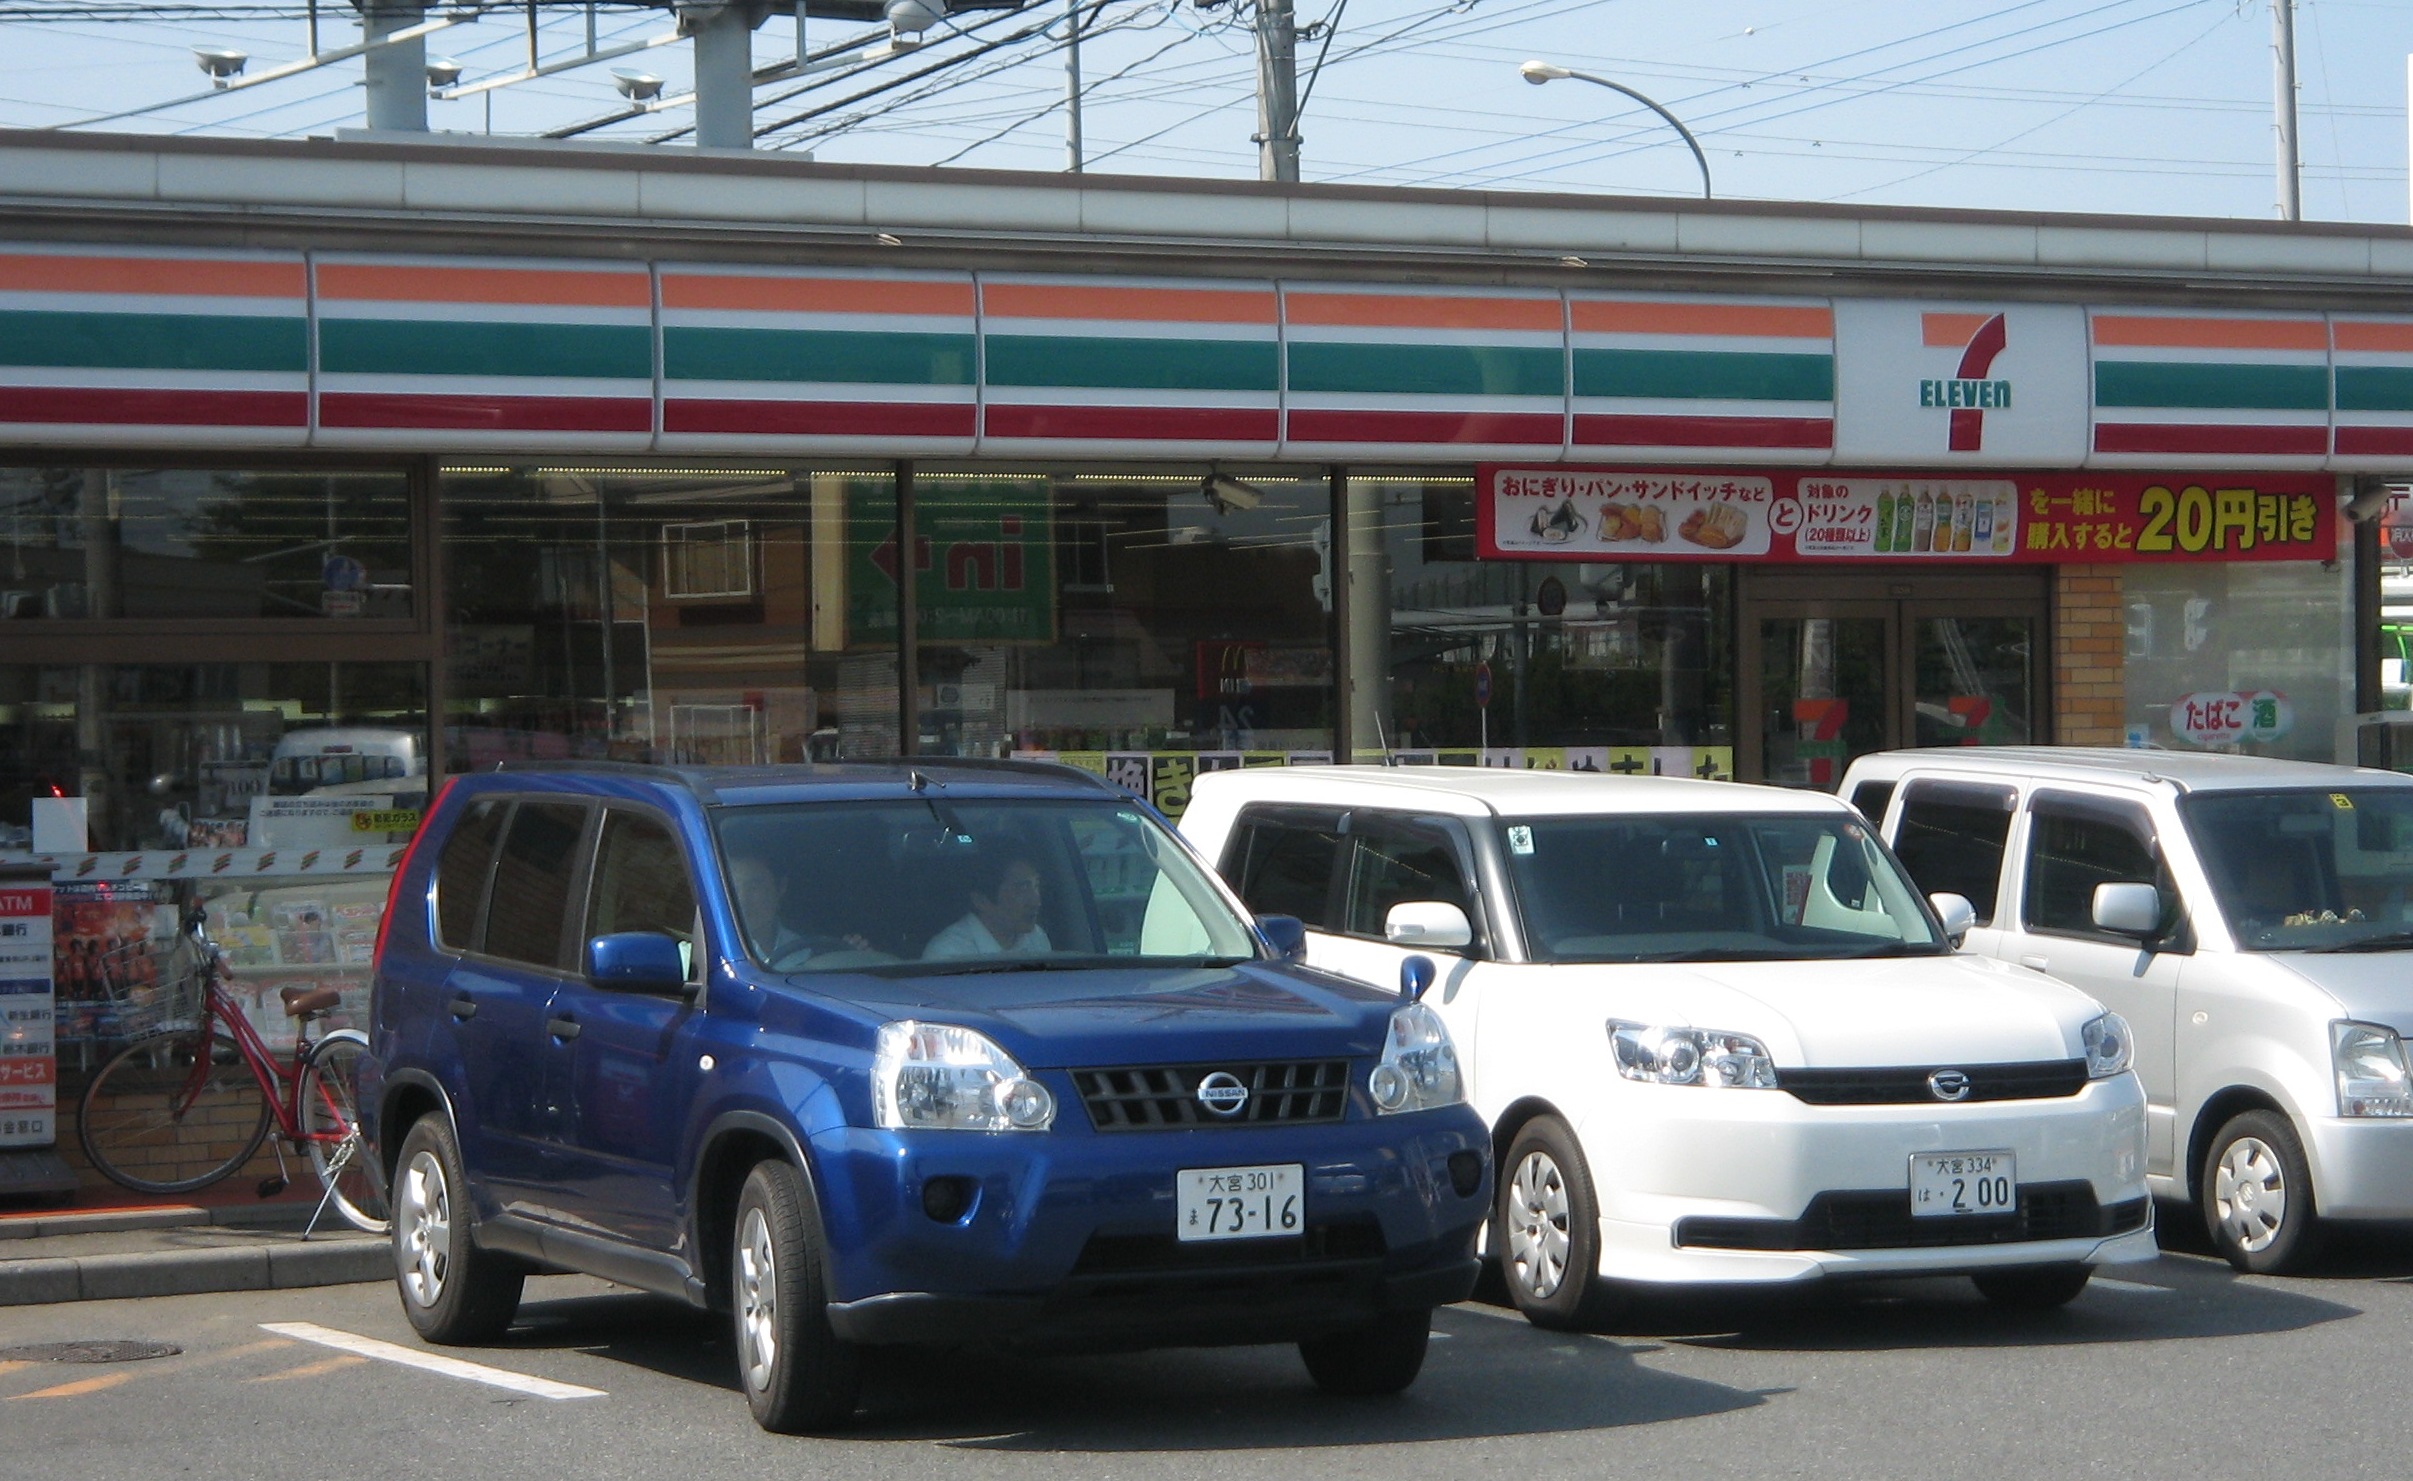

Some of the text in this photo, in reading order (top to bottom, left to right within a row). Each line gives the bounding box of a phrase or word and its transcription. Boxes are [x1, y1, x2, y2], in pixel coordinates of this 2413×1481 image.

[1921, 312, 2006, 451] 7
[1775, 503, 1794, 527] と
[1807, 504, 1872, 523] ドリンク
[2030, 488, 2115, 515] を一緒に
[2136, 486, 2317, 553] 20円引き
[2026, 522, 2132, 550] 購入すると
[2186, 699, 2242, 730] たばこ
[2253, 699, 2276, 728] 酒
[0, 923, 27, 936] 銀行
[1205, 1088, 1246, 1098] NISSAN
[0, 1120, 43, 1134] 金窓口
[1206, 1195, 1297, 1234] 73-16
